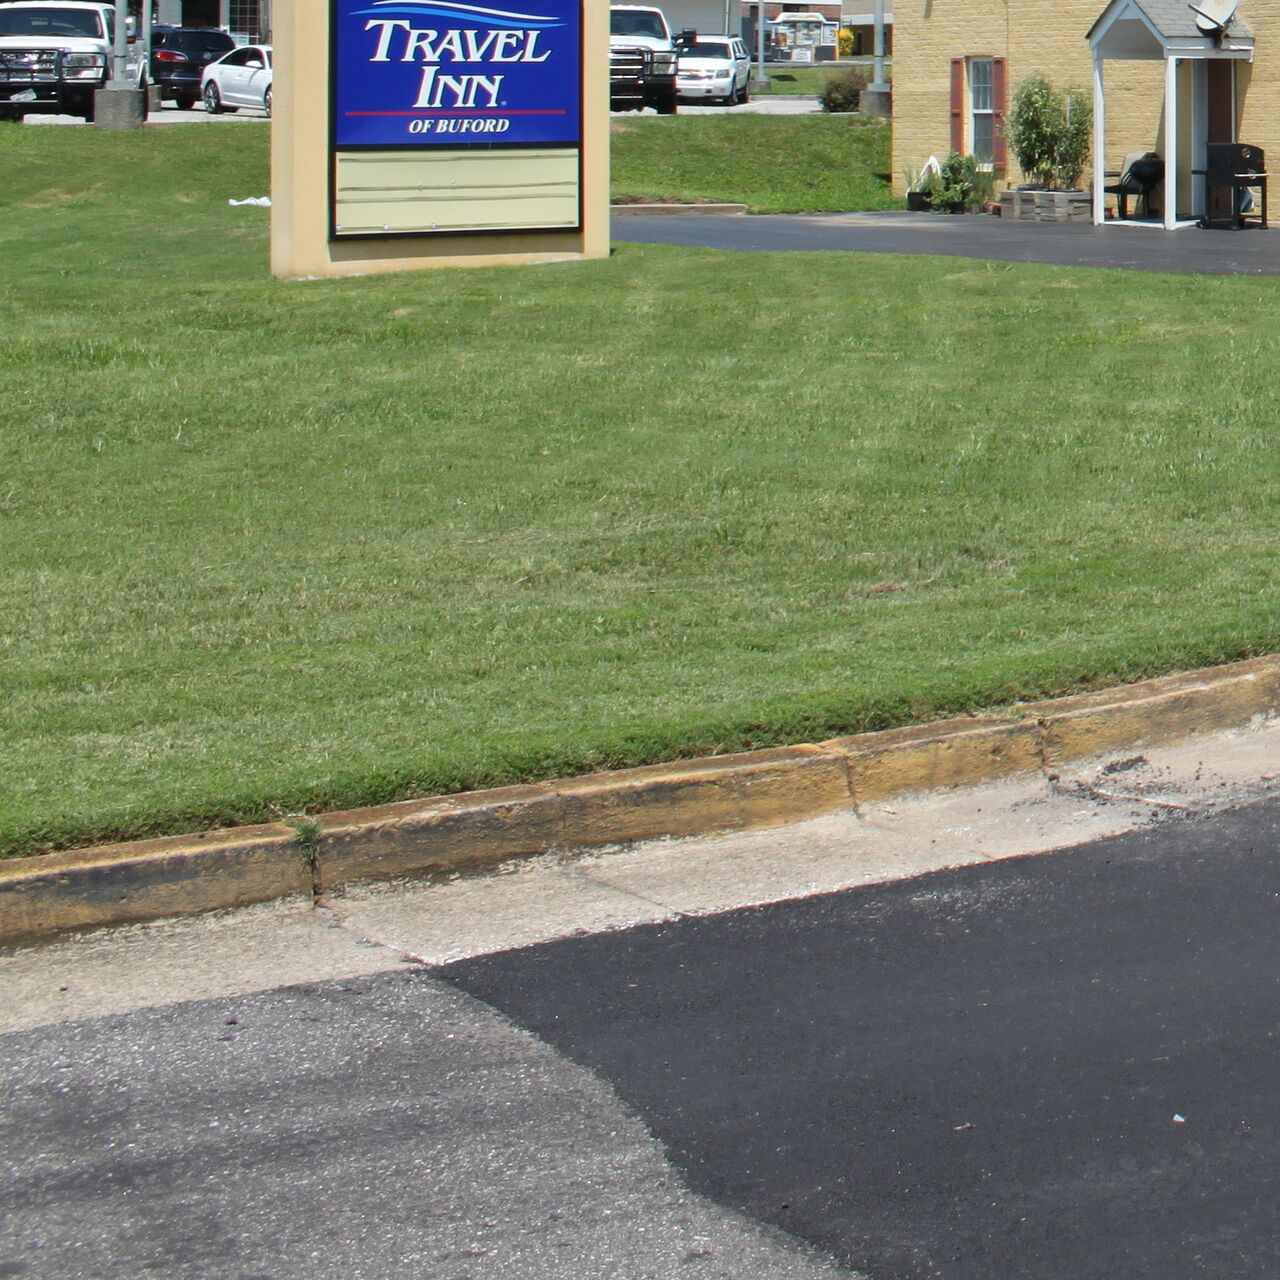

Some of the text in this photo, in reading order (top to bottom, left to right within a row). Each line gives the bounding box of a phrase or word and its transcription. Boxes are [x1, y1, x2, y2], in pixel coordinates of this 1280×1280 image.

[364, 19, 552, 63] TRAVEL
[412, 65, 505, 108] INN
[409, 118, 510, 134] OF BUFORD
